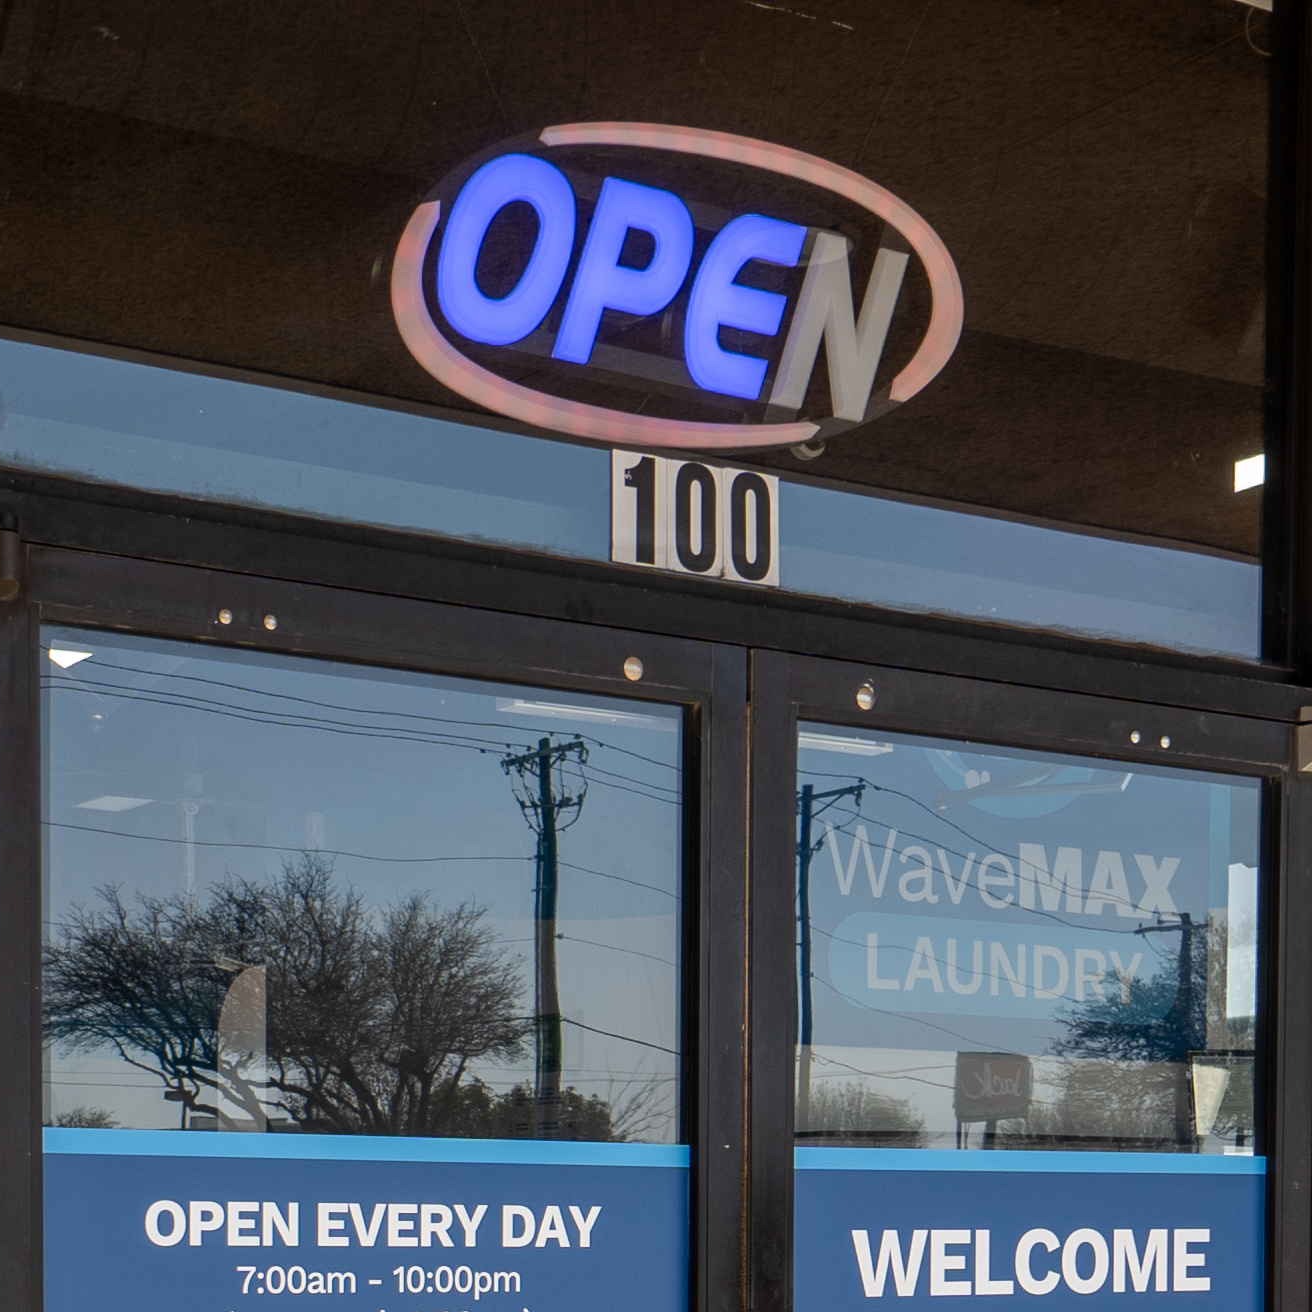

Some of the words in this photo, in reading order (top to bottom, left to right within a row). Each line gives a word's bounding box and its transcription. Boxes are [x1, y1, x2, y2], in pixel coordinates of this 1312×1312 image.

[437, 153, 910, 422] OPEN
[624, 455, 771, 581] 100
[825, 821, 1182, 920] WaveMAX
[866, 933, 1144, 1005] LAUNDRY
[144, 1200, 299, 1247] OPEN
[317, 1202, 488, 1248] EVERY
[501, 1205, 602, 1248] DAY
[237, 1265, 356, 1295] 7:00am
[393, 1265, 522, 1300] 10:00pm
[851, 1228, 1211, 1298] WELCOME
